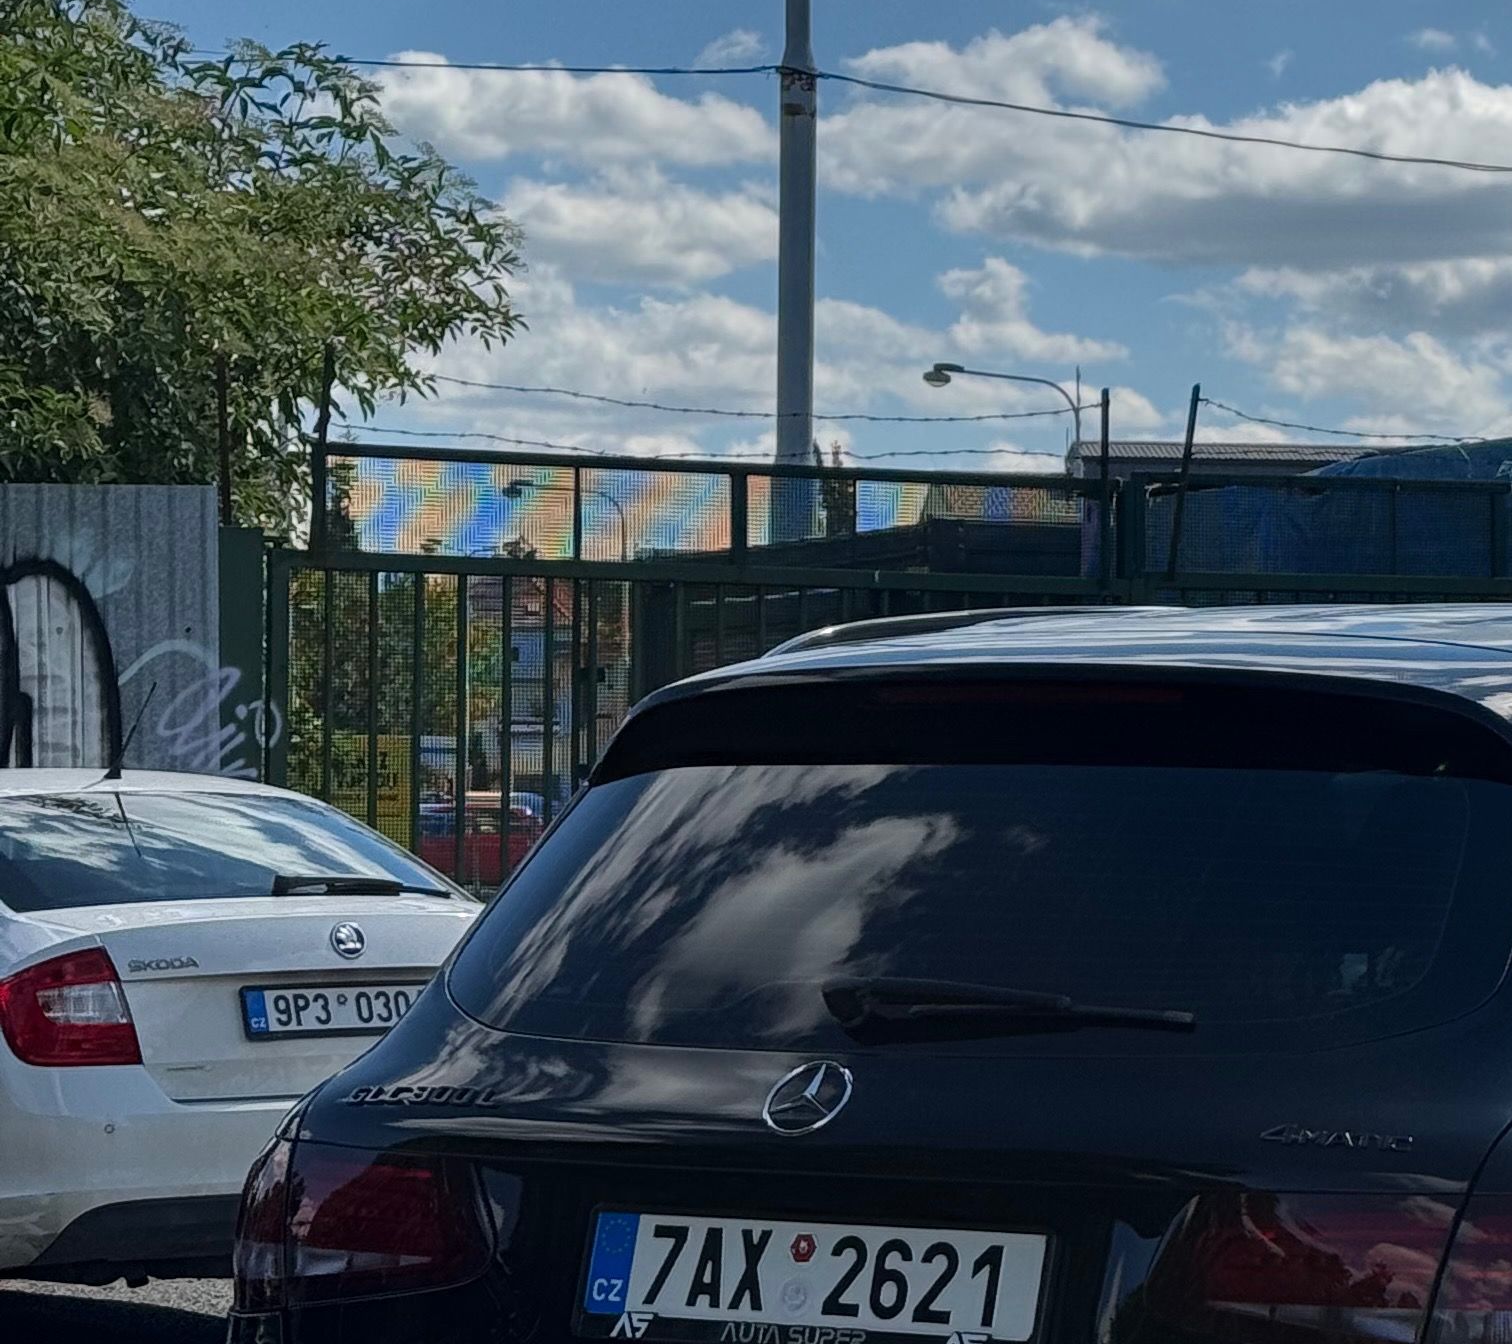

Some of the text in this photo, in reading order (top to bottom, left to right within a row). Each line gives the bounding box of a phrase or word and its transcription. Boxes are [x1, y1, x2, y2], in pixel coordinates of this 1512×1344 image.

[251, 1017, 267, 1028] CZ
[273, 989, 421, 1026] 9P3 030
[592, 1278, 623, 1302] CZ
[642, 1224, 1006, 1328] 7AX 2621
